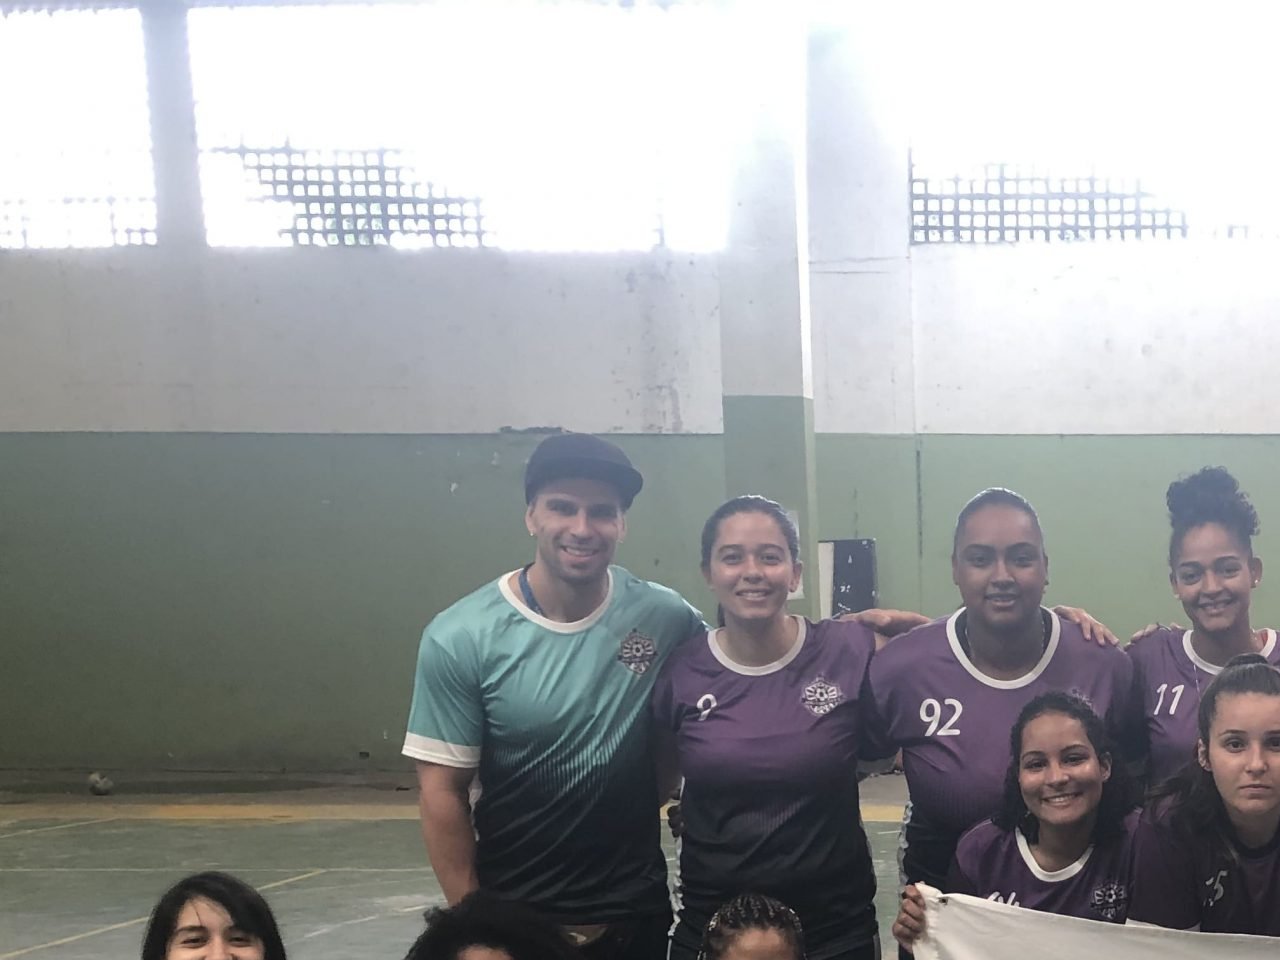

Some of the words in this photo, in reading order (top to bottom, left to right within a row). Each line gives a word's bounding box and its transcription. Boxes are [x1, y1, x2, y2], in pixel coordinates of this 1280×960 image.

[696, 693, 718, 722] 9
[1153, 683, 1185, 716] 11
[919, 698, 963, 737] 92
